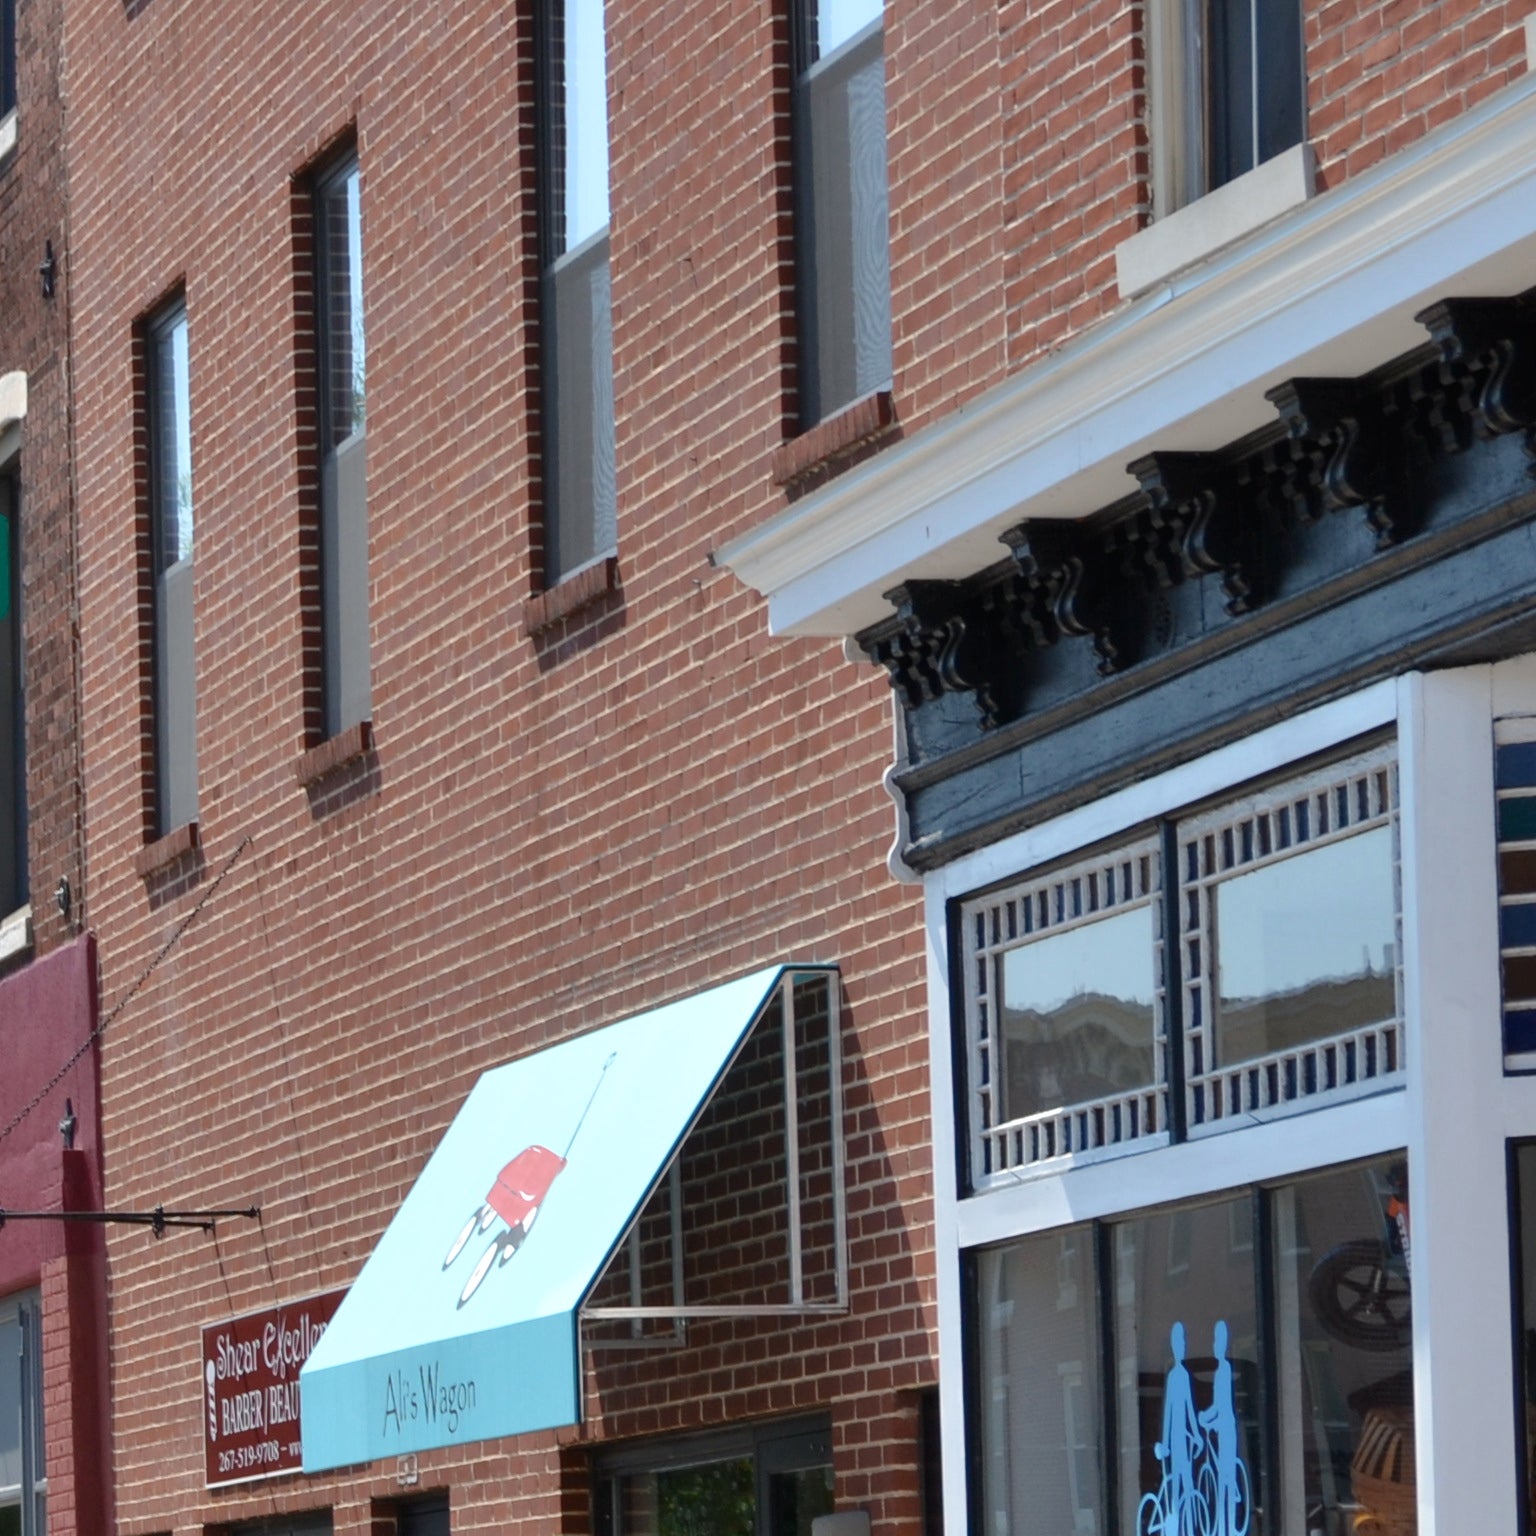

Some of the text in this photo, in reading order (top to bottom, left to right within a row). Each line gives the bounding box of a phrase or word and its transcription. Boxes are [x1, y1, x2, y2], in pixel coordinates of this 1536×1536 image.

[216, 1334, 261, 1381] Shear
[382, 1360, 477, 1438] Ali's Wagon
[218, 1440, 280, 1472] 267-519-9708
